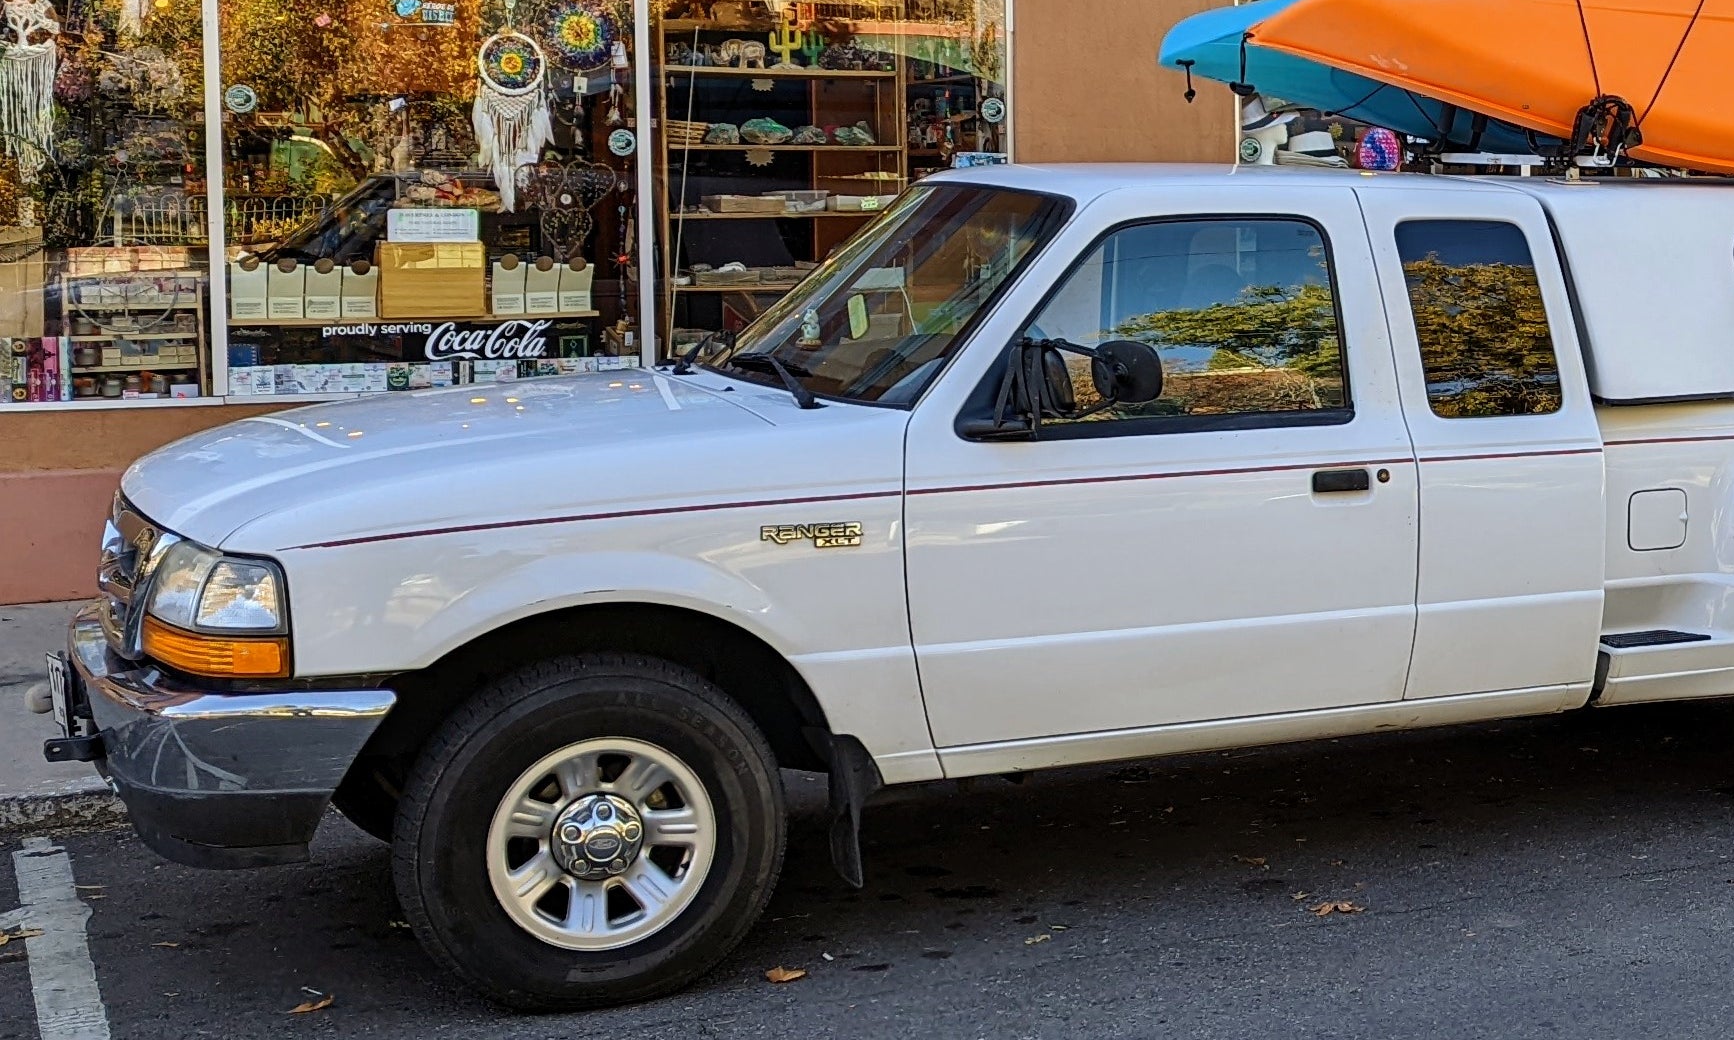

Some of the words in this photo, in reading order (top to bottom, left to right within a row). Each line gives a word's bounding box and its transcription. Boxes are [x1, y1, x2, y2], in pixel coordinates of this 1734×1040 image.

[322, 323, 378, 338] proudly
[380, 322, 432, 335] serving
[425, 320, 554, 360] Coca-Cola
[760, 522, 863, 545] RANGER
